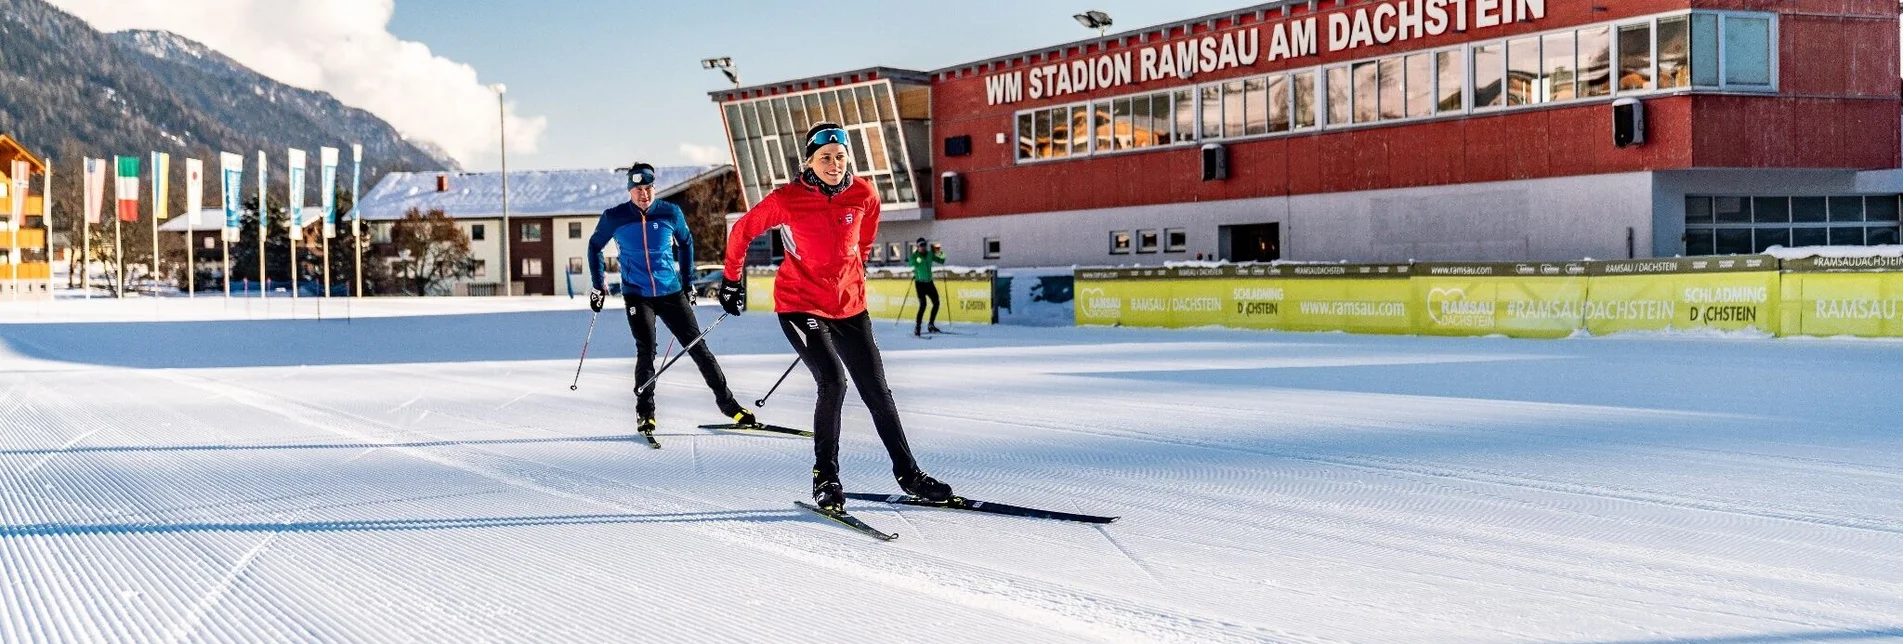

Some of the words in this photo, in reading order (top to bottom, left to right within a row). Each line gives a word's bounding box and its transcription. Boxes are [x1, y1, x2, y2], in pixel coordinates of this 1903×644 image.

[986, 71, 1022, 105] WM
[1029, 52, 1132, 99] STADION
[1140, 28, 1259, 82] RAMSAU
[1268, 17, 1317, 61] AM
[1431, 265, 1493, 275] www.ramsau.com
[1605, 263, 1634, 273] RAMSAU
[1639, 261, 1677, 272] DACHSTEIN
[1233, 287, 1284, 300] SCHLADMING
[1684, 286, 1767, 303] SCHLADMING
[1088, 297, 1121, 309] RAMSAU
[1130, 298, 1166, 311] RAMSAU
[1172, 298, 1222, 312] DACHSTEIN
[1300, 299, 1405, 316] www.ramsau.com
[1441, 301, 1495, 315] RAMSAU
[1507, 299, 1675, 320] #RAMSAUDACHSTEIN
[1815, 298, 1897, 319] RAMSAU
[1441, 315, 1495, 327] DACHSTEIN
